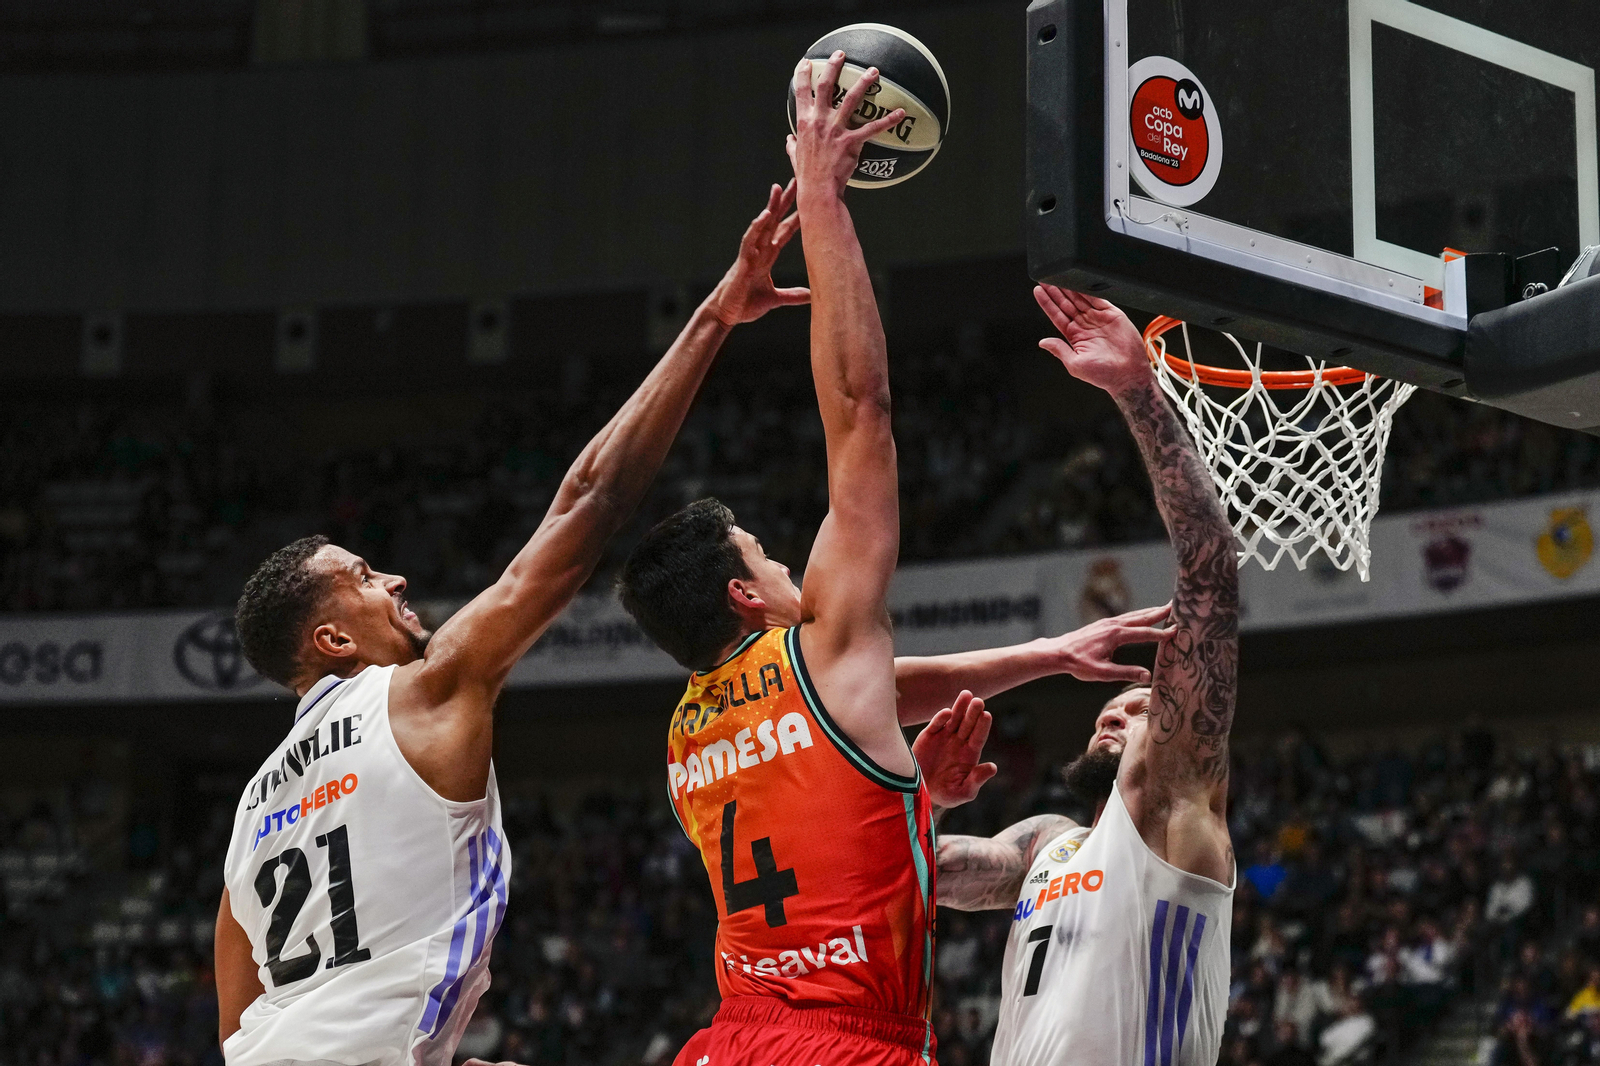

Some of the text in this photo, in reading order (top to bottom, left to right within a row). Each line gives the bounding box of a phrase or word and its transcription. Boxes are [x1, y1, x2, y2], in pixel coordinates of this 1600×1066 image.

[1152, 106, 1172, 120] acb
[1144, 113, 1183, 139] Copa
[1147, 133, 1162, 144] del
[1140, 149, 1170, 165] Badalona
[1163, 137, 1188, 161] Rey
[859, 160, 897, 177] 2023
[668, 711, 814, 800] PAMESA
[720, 799, 800, 928] 4
[253, 823, 372, 988] 21
[720, 924, 869, 980] isaval
